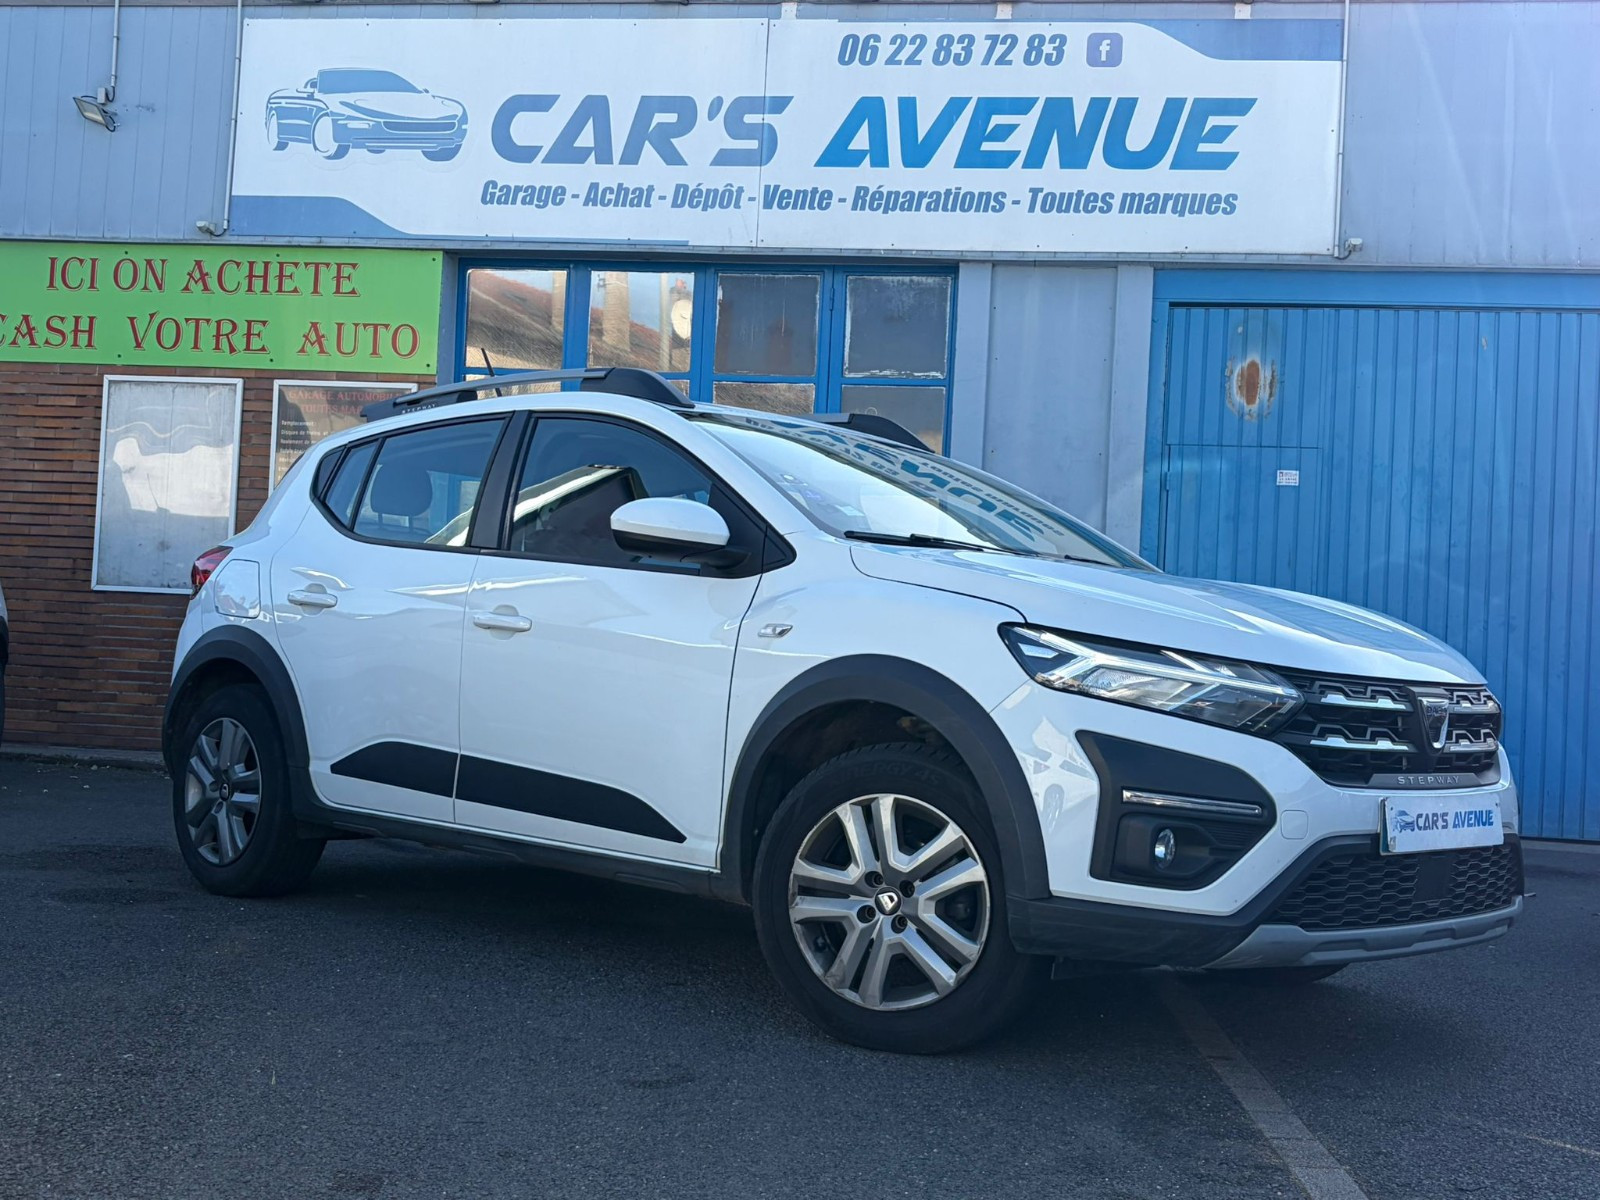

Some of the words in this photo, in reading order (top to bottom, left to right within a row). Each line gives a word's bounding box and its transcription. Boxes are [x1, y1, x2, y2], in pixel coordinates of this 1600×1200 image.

[838, 34, 881, 66] 06
[884, 34, 927, 66] 22
[932, 34, 974, 66] 83
[981, 34, 1020, 66] 72
[1023, 34, 1067, 66] 83
[491, 94, 795, 167] CAR'S
[813, 96, 1258, 171] AVENUE
[480, 180, 567, 209] Garage
[583, 182, 655, 209] Achat
[671, 183, 745, 212] Dépôt
[762, 184, 834, 211] Vente
[851, 185, 1007, 215] Réparations
[1027, 187, 1113, 214] Toutes
[1118, 191, 1239, 218] marques
[46, 256, 100, 291] ICI
[113, 257, 169, 293] ON
[180, 259, 361, 298] ACHETE
[127, 311, 270, 355] VOTRE
[297, 321, 420, 359] AUTO
[289, 391, 333, 400] GARAGE
[1398, 776, 1460, 785] STEPWAY
[1415, 812, 1449, 831] CAR'S
[1452, 809, 1494, 828] AVENUE
